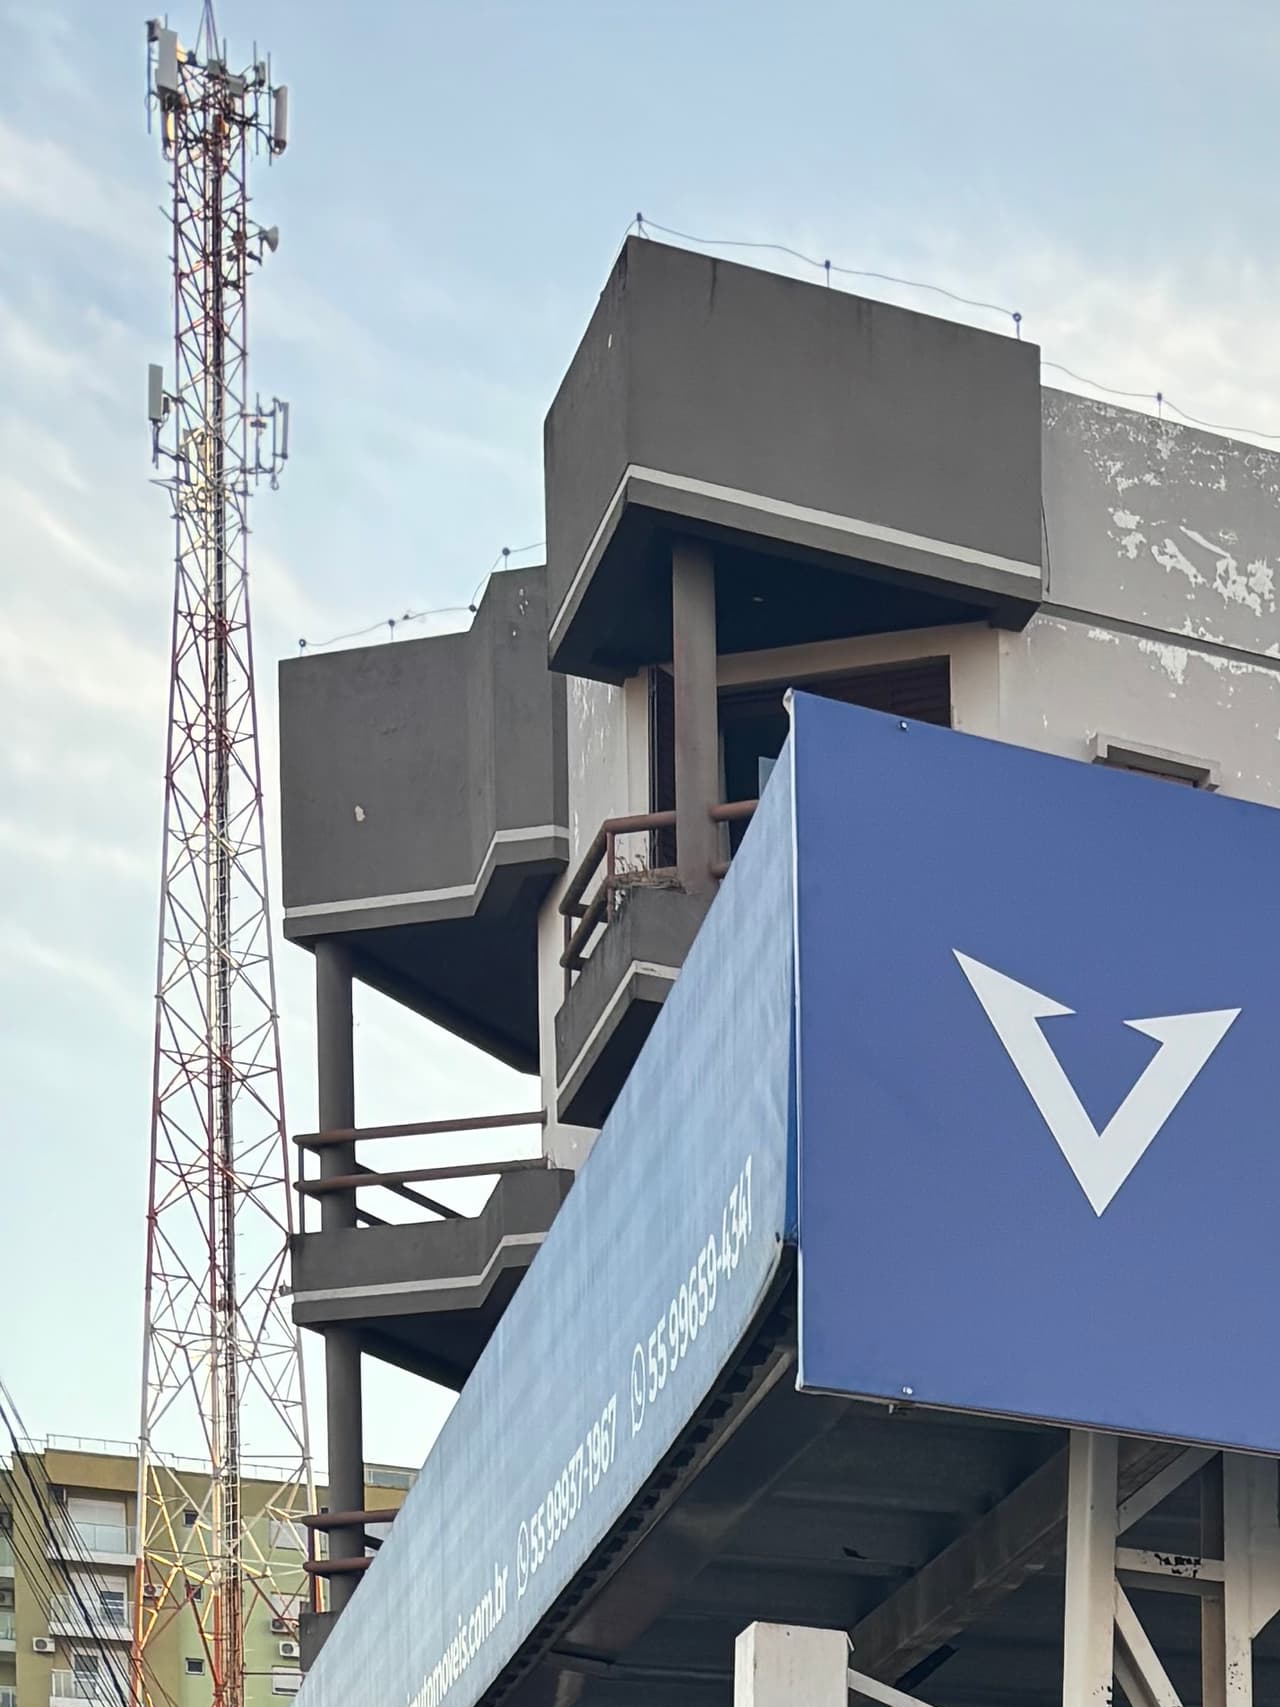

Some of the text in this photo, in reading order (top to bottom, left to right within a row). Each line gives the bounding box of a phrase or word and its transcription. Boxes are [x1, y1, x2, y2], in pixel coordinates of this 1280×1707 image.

[648, 1154, 752, 1403] 55 99659-4341
[530, 1392, 617, 1573] 55 99937-1967
